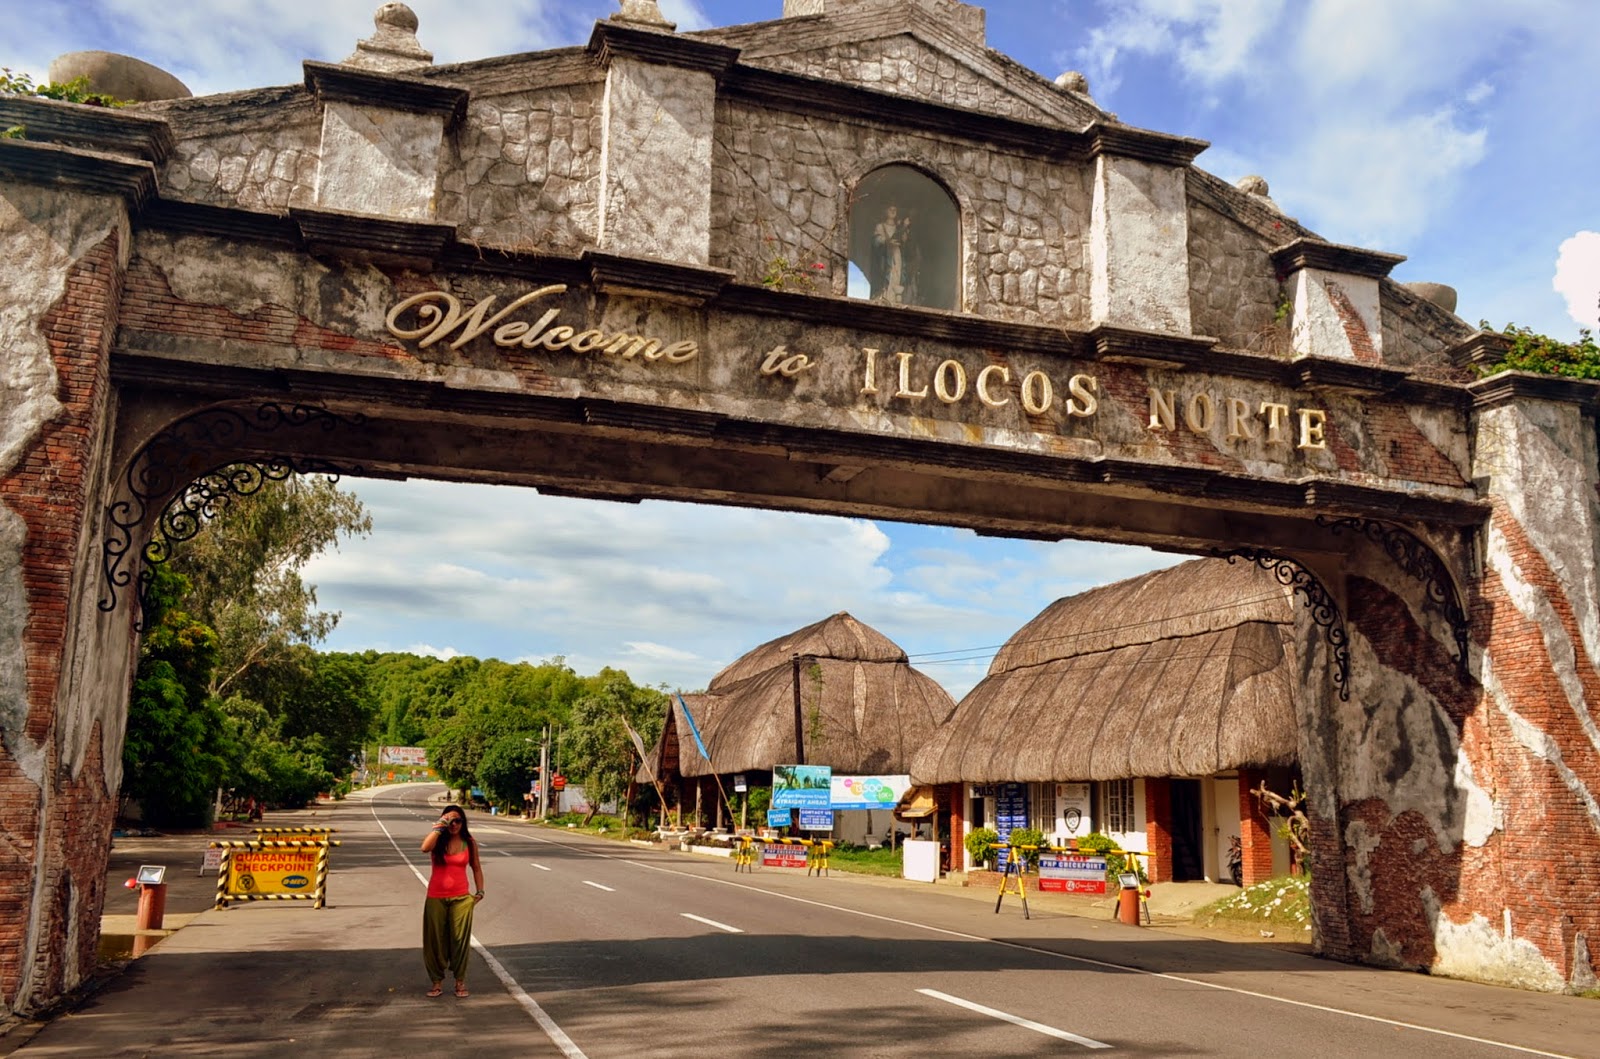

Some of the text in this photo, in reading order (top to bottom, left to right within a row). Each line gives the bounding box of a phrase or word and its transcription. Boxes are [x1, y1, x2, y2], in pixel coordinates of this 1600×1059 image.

[386, 283, 1327, 450] Welcome to ILOCOS NORTE
[235, 853, 315, 863] QUARANTINE
[234, 863, 314, 872] CHECKPOINT
[1058, 861, 1102, 870] CHECKPOINT
